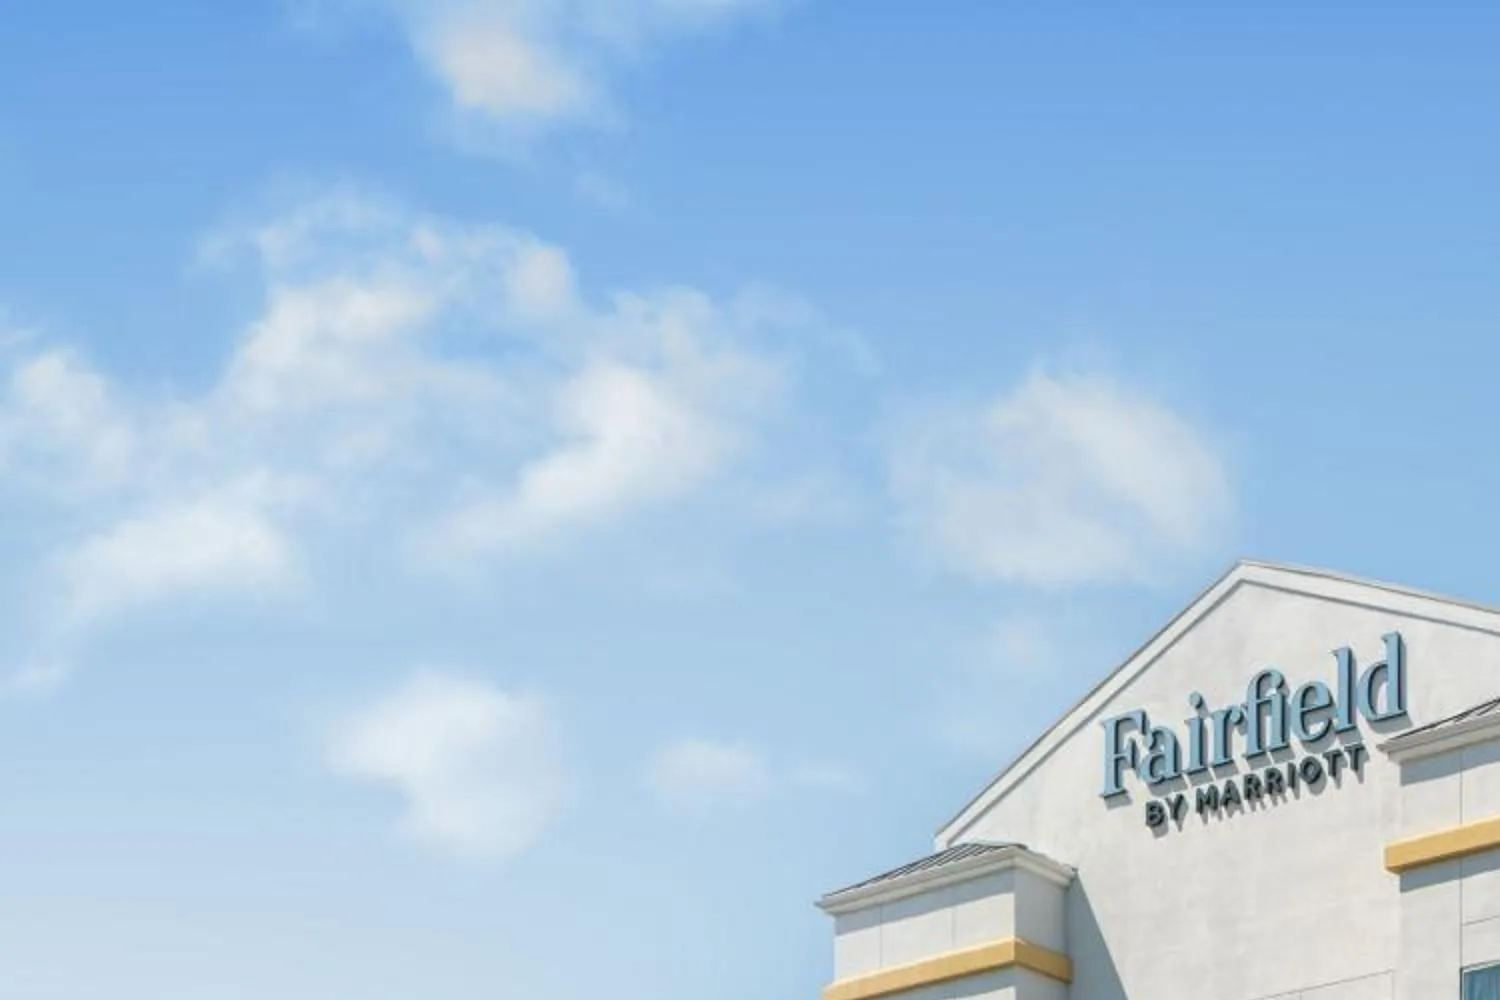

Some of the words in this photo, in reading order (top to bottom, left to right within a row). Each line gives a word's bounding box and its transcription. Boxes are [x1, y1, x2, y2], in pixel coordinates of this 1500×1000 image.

[1100, 631, 1408, 799] Fairfield
[1145, 793, 1187, 828] BY
[1195, 743, 1367, 816] MARRIOTT
